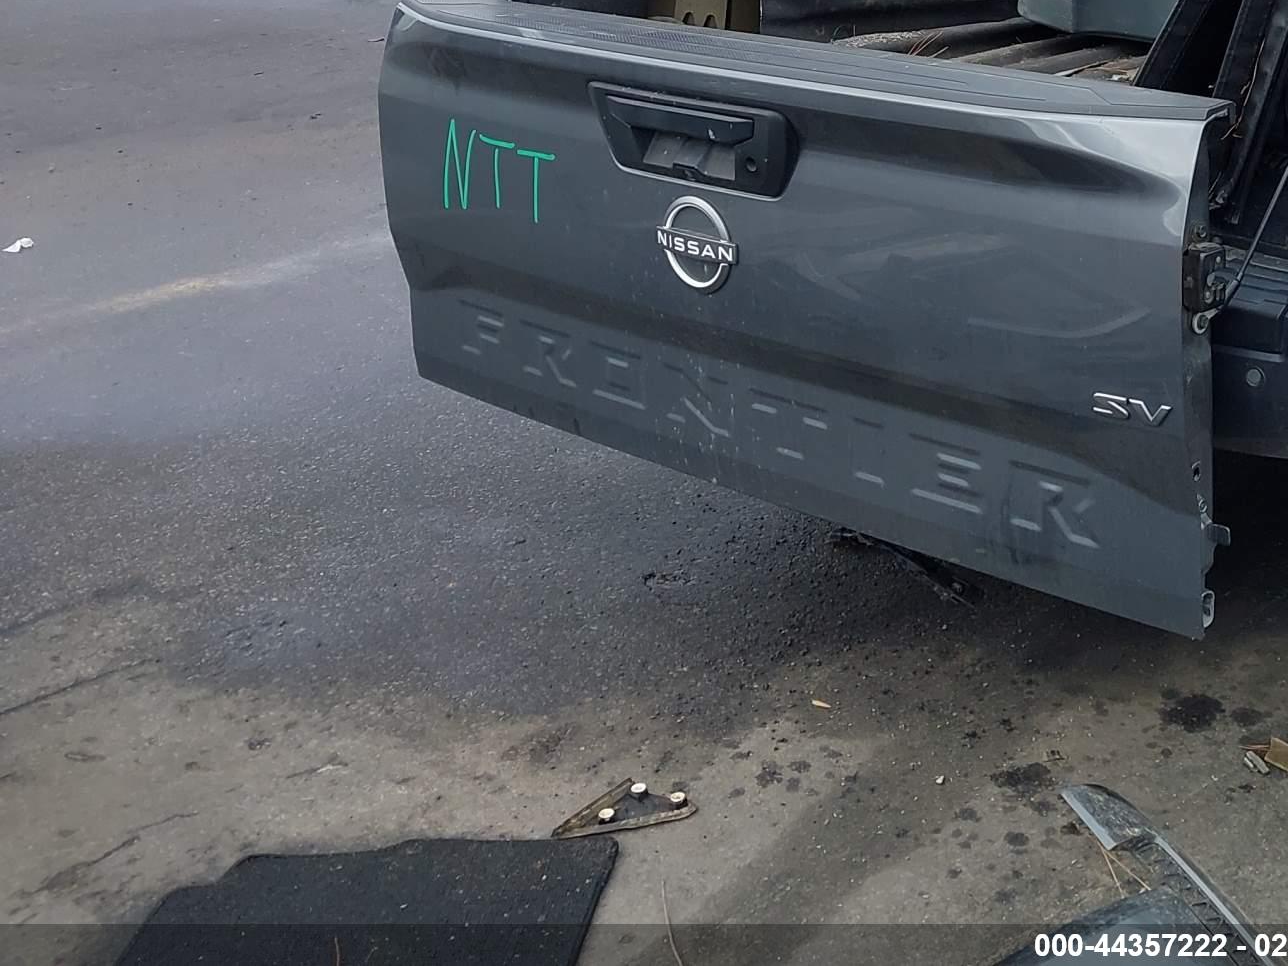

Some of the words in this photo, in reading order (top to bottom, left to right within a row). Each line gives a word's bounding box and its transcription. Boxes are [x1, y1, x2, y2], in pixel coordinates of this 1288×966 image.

[443, 118, 556, 223] NTT
[656, 229, 734, 262] NISSAN
[458, 298, 1101, 549] FRONTIER
[1092, 392, 1172, 427] SV
